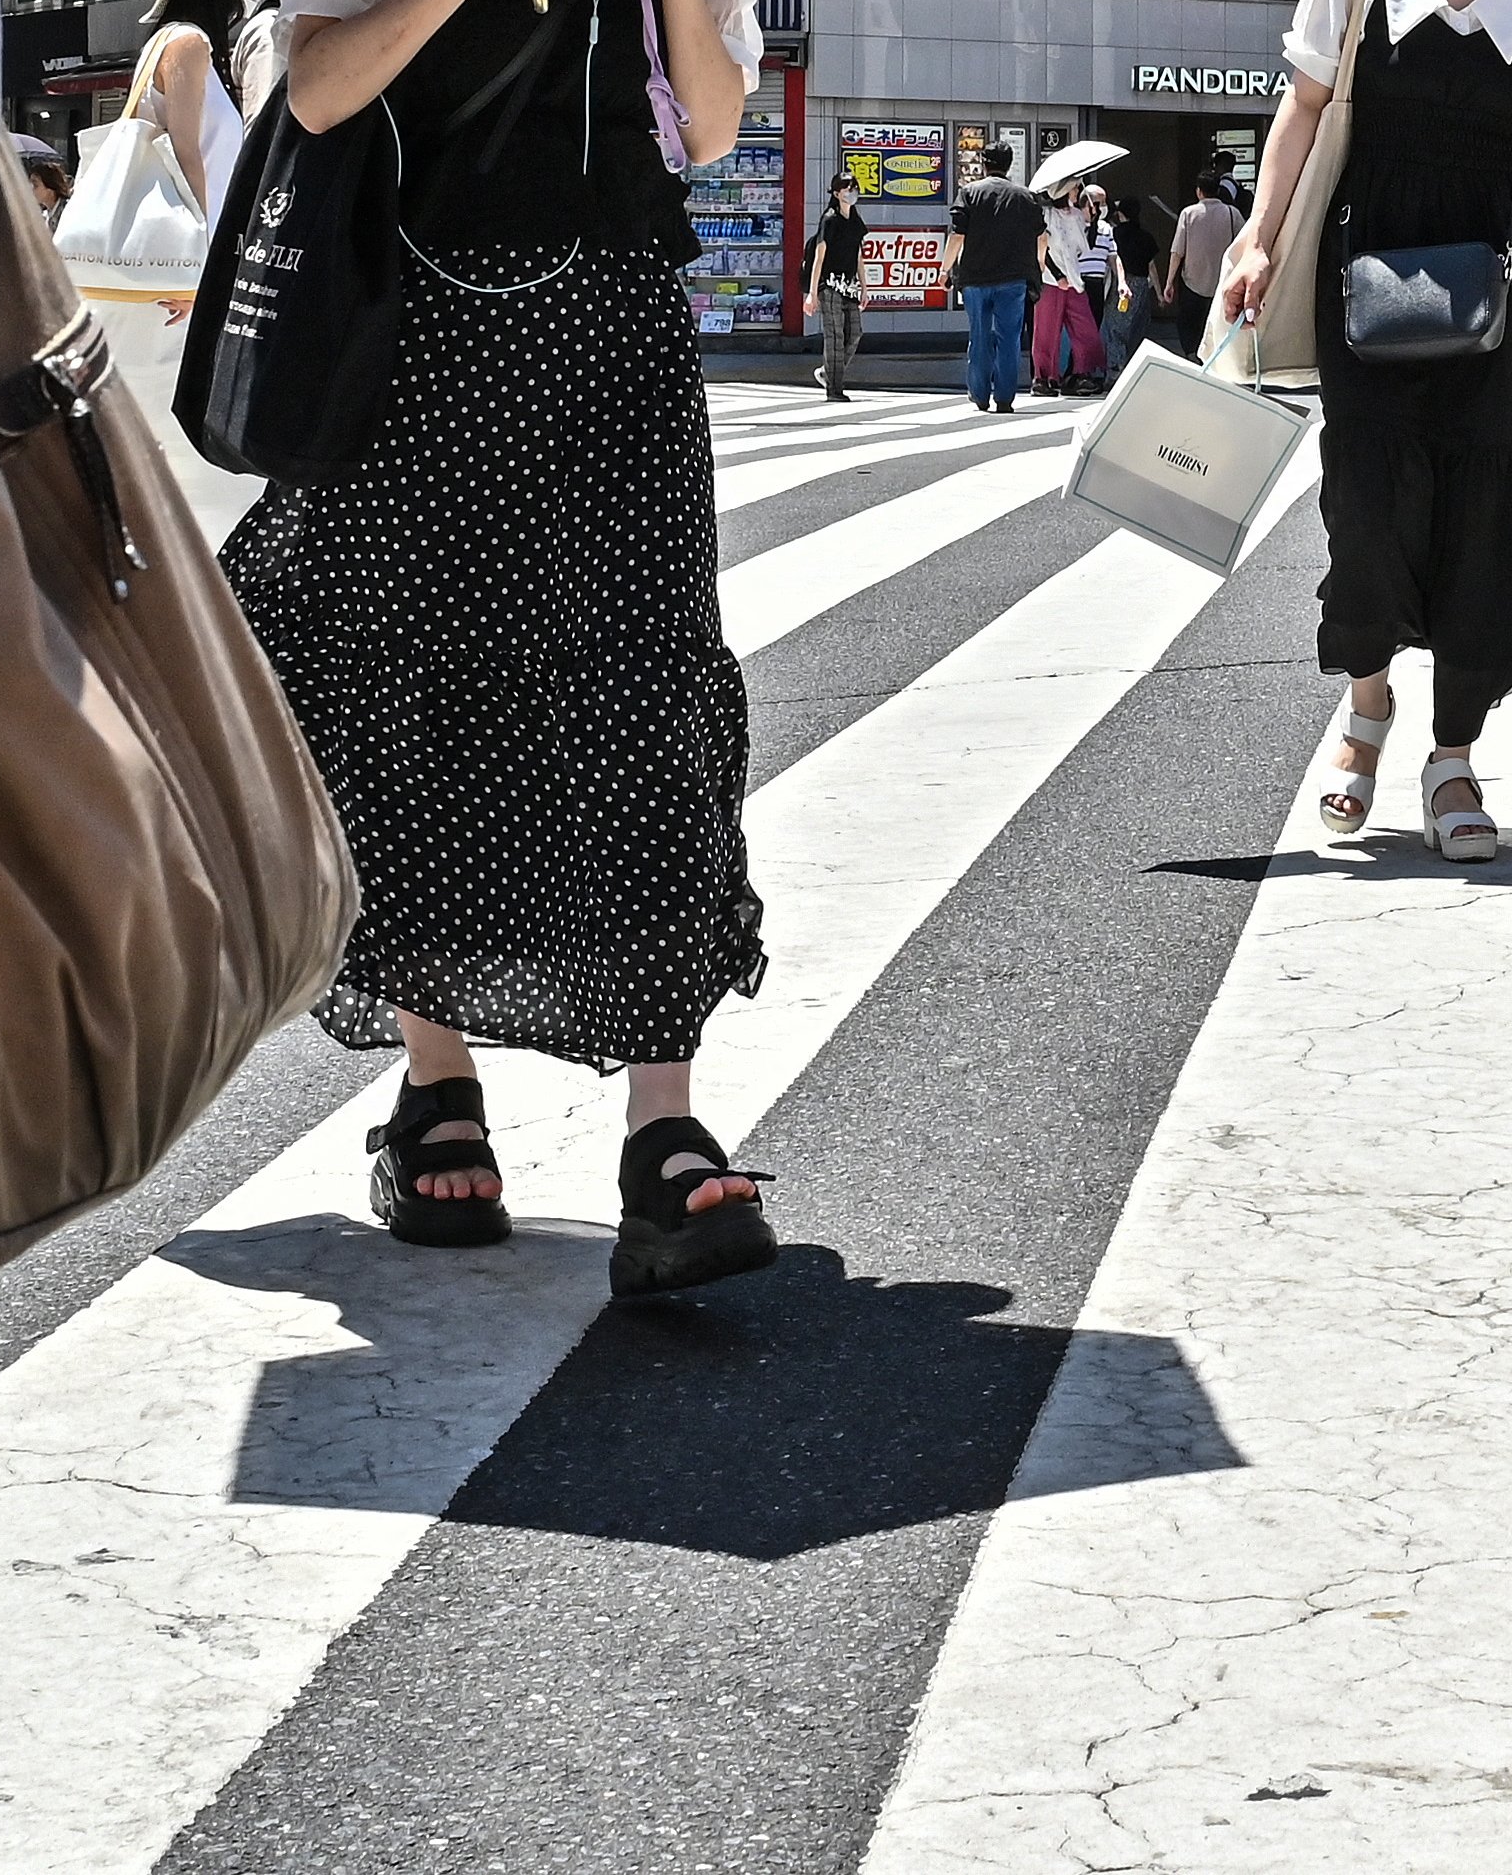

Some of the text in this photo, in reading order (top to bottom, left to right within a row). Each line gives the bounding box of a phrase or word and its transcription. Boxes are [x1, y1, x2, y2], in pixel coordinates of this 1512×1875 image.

[1137, 65, 1294, 97] PANDORA
[845, 154, 880, 195] 薬
[862, 235, 938, 260] ax-free
[107, 256, 143, 267] LOUIS
[148, 257, 202, 268] VUITTON
[889, 262, 938, 287] Shop
